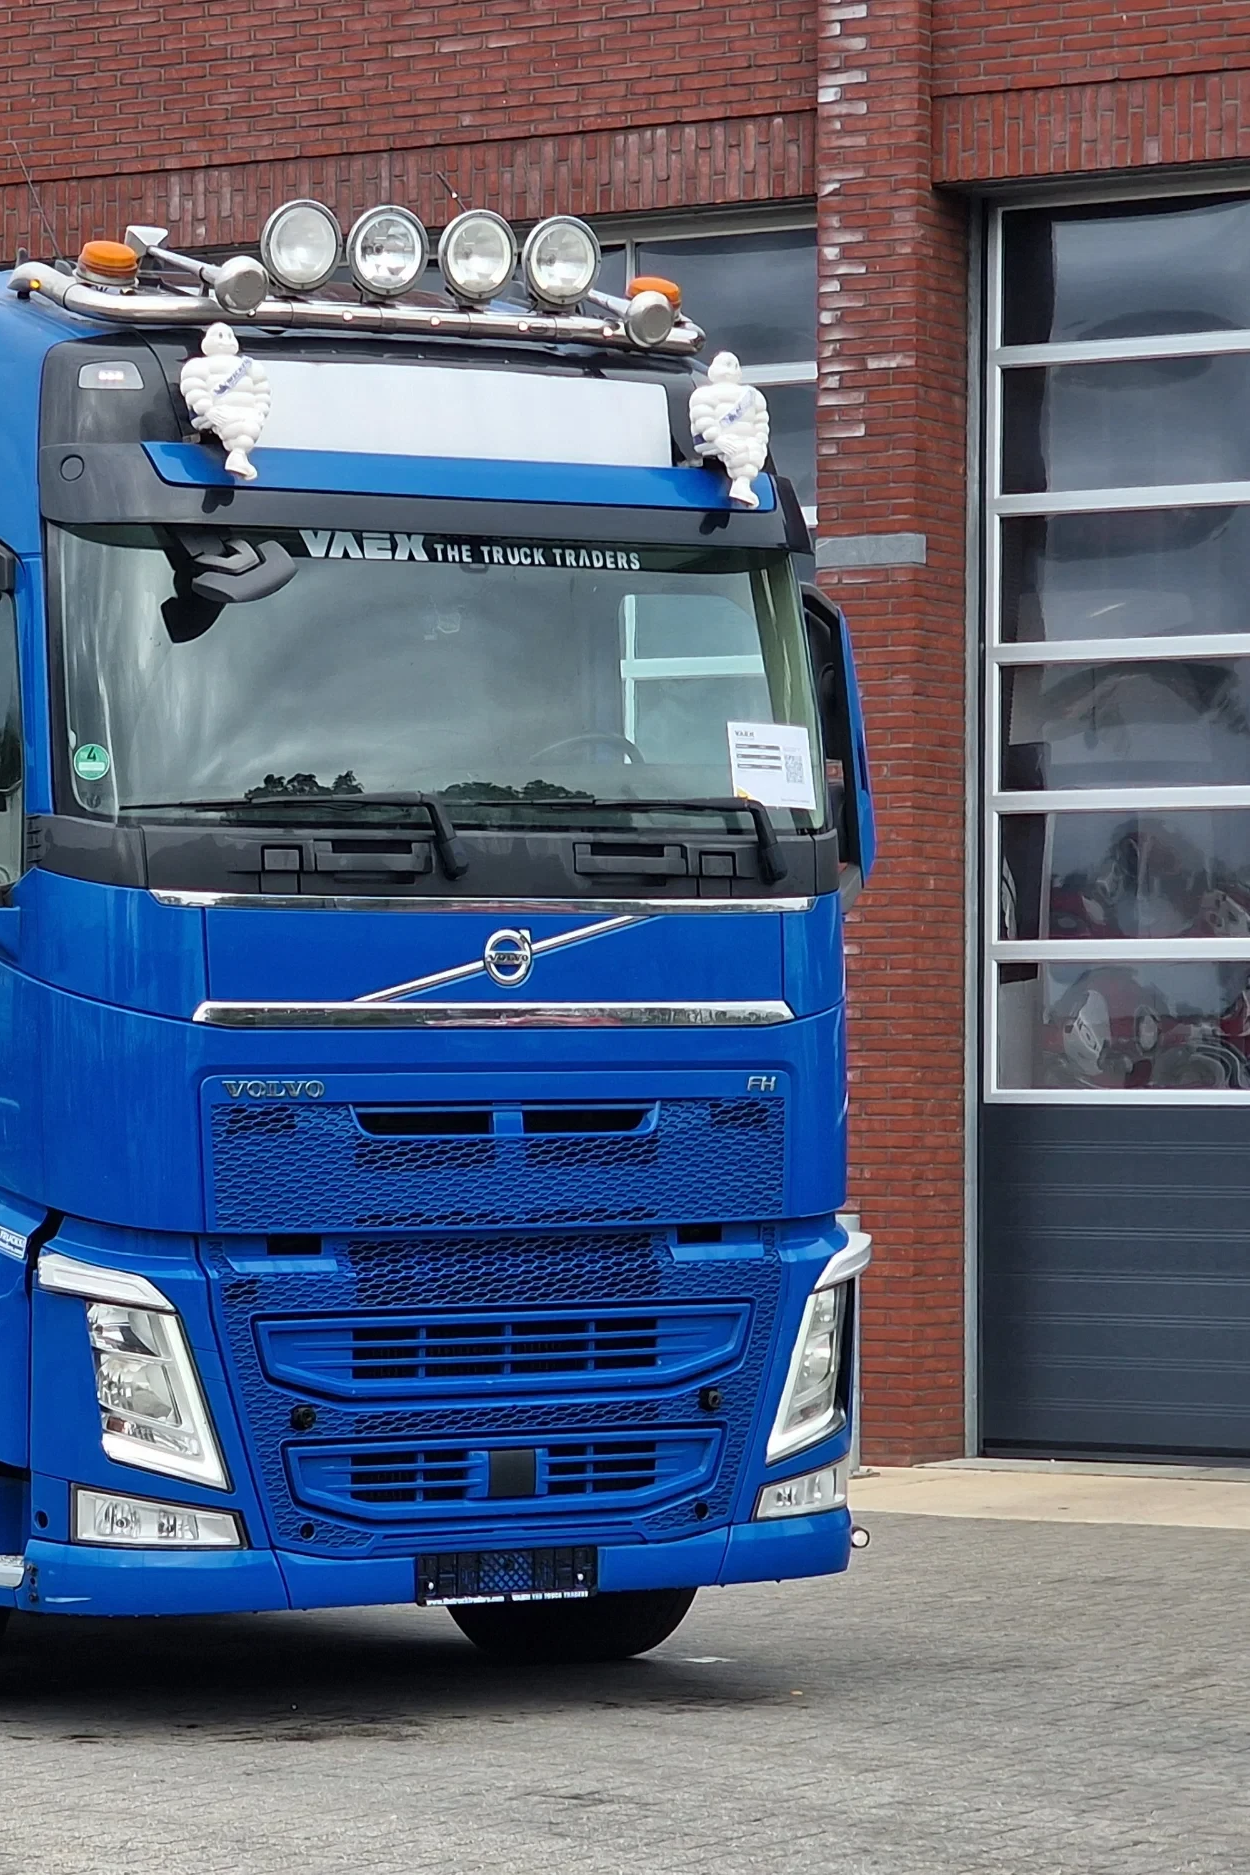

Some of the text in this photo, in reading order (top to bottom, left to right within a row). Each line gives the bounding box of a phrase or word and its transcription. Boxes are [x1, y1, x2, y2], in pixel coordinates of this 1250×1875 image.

[299, 529, 641, 570] VAEX THE TRUCK TRADERS
[86, 746, 97, 762] 4
[488, 954, 529, 962] VOLVO
[221, 1080, 325, 1098] VOLVO
[747, 1075, 776, 1091] FH
